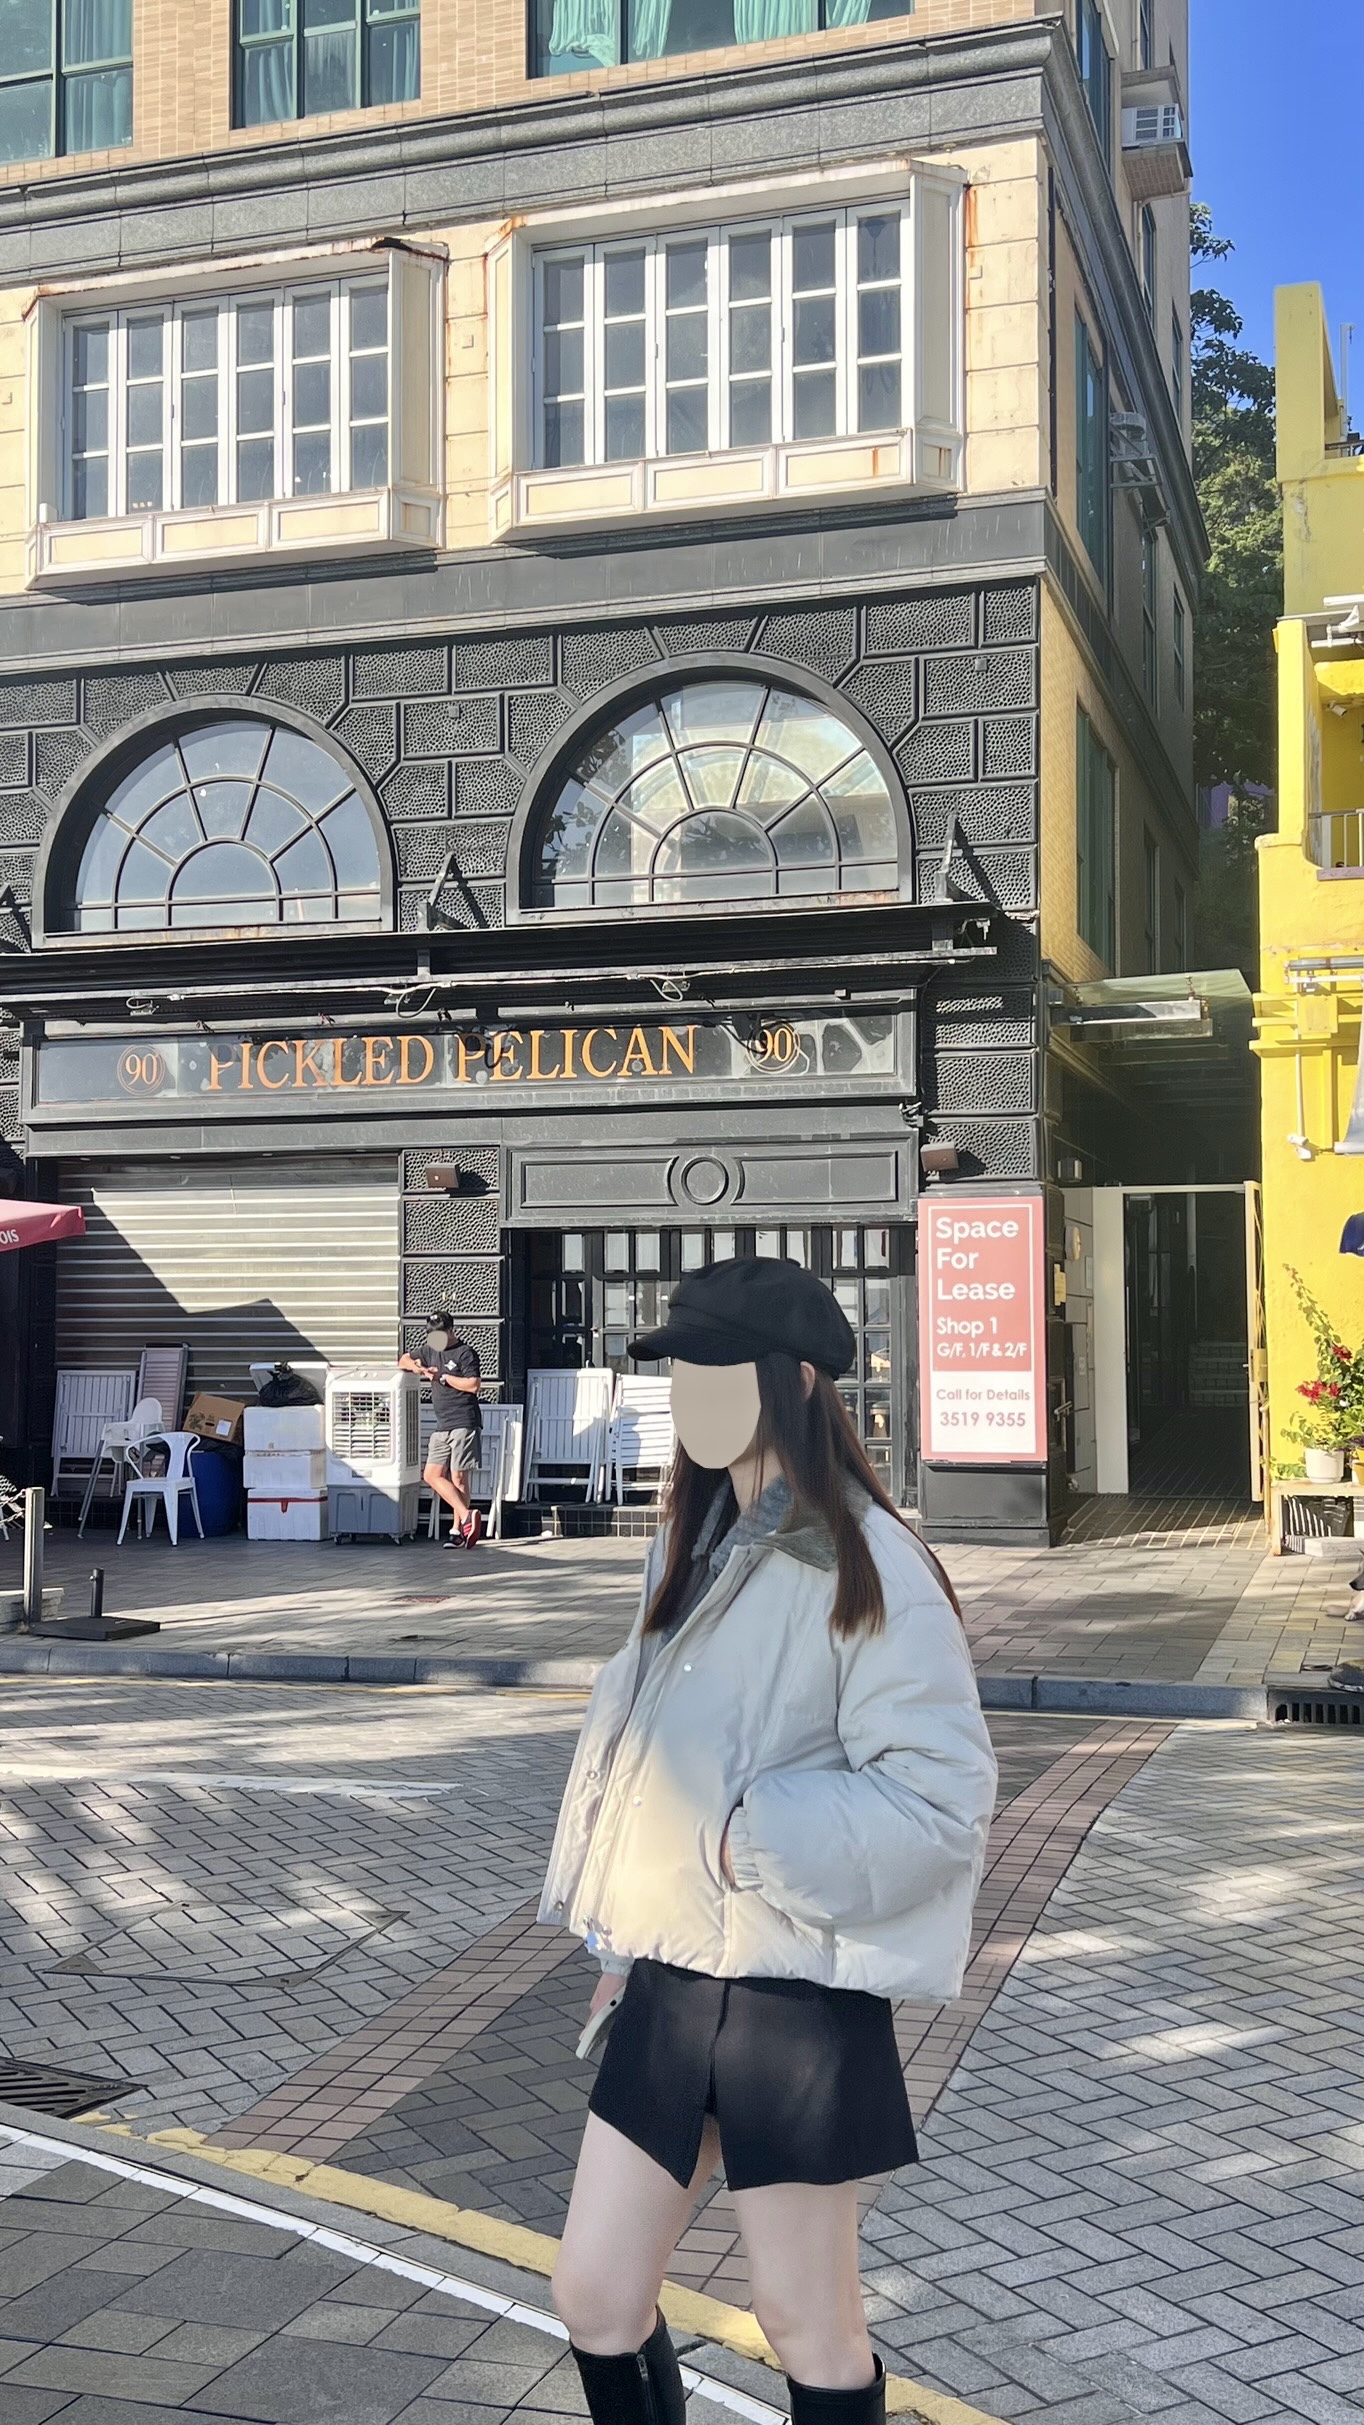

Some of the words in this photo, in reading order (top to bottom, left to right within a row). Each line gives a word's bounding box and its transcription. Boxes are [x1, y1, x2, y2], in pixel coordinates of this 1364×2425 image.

[125, 1053, 159, 1085] 90
[453, 1024, 699, 1082] PELICAN
[936, 1216, 1019, 1244] Space
[937, 1247, 979, 1270] For
[937, 1278, 1016, 1300] Lease
[936, 1317, 985, 1338] Shop
[989, 1317, 998, 1334] 1
[937, 1342, 966, 1358] G/F,
[969, 1342, 990, 1358] 1/F
[992, 1343, 1003, 1357] &
[1004, 1342, 1027, 1358] 2/F
[936, 1389, 962, 1401] Call
[965, 1389, 982, 1401] for
[986, 1389, 1031, 1401] Details
[940, 1411, 980, 1427] 3519
[986, 1411, 1027, 1427] 9355
